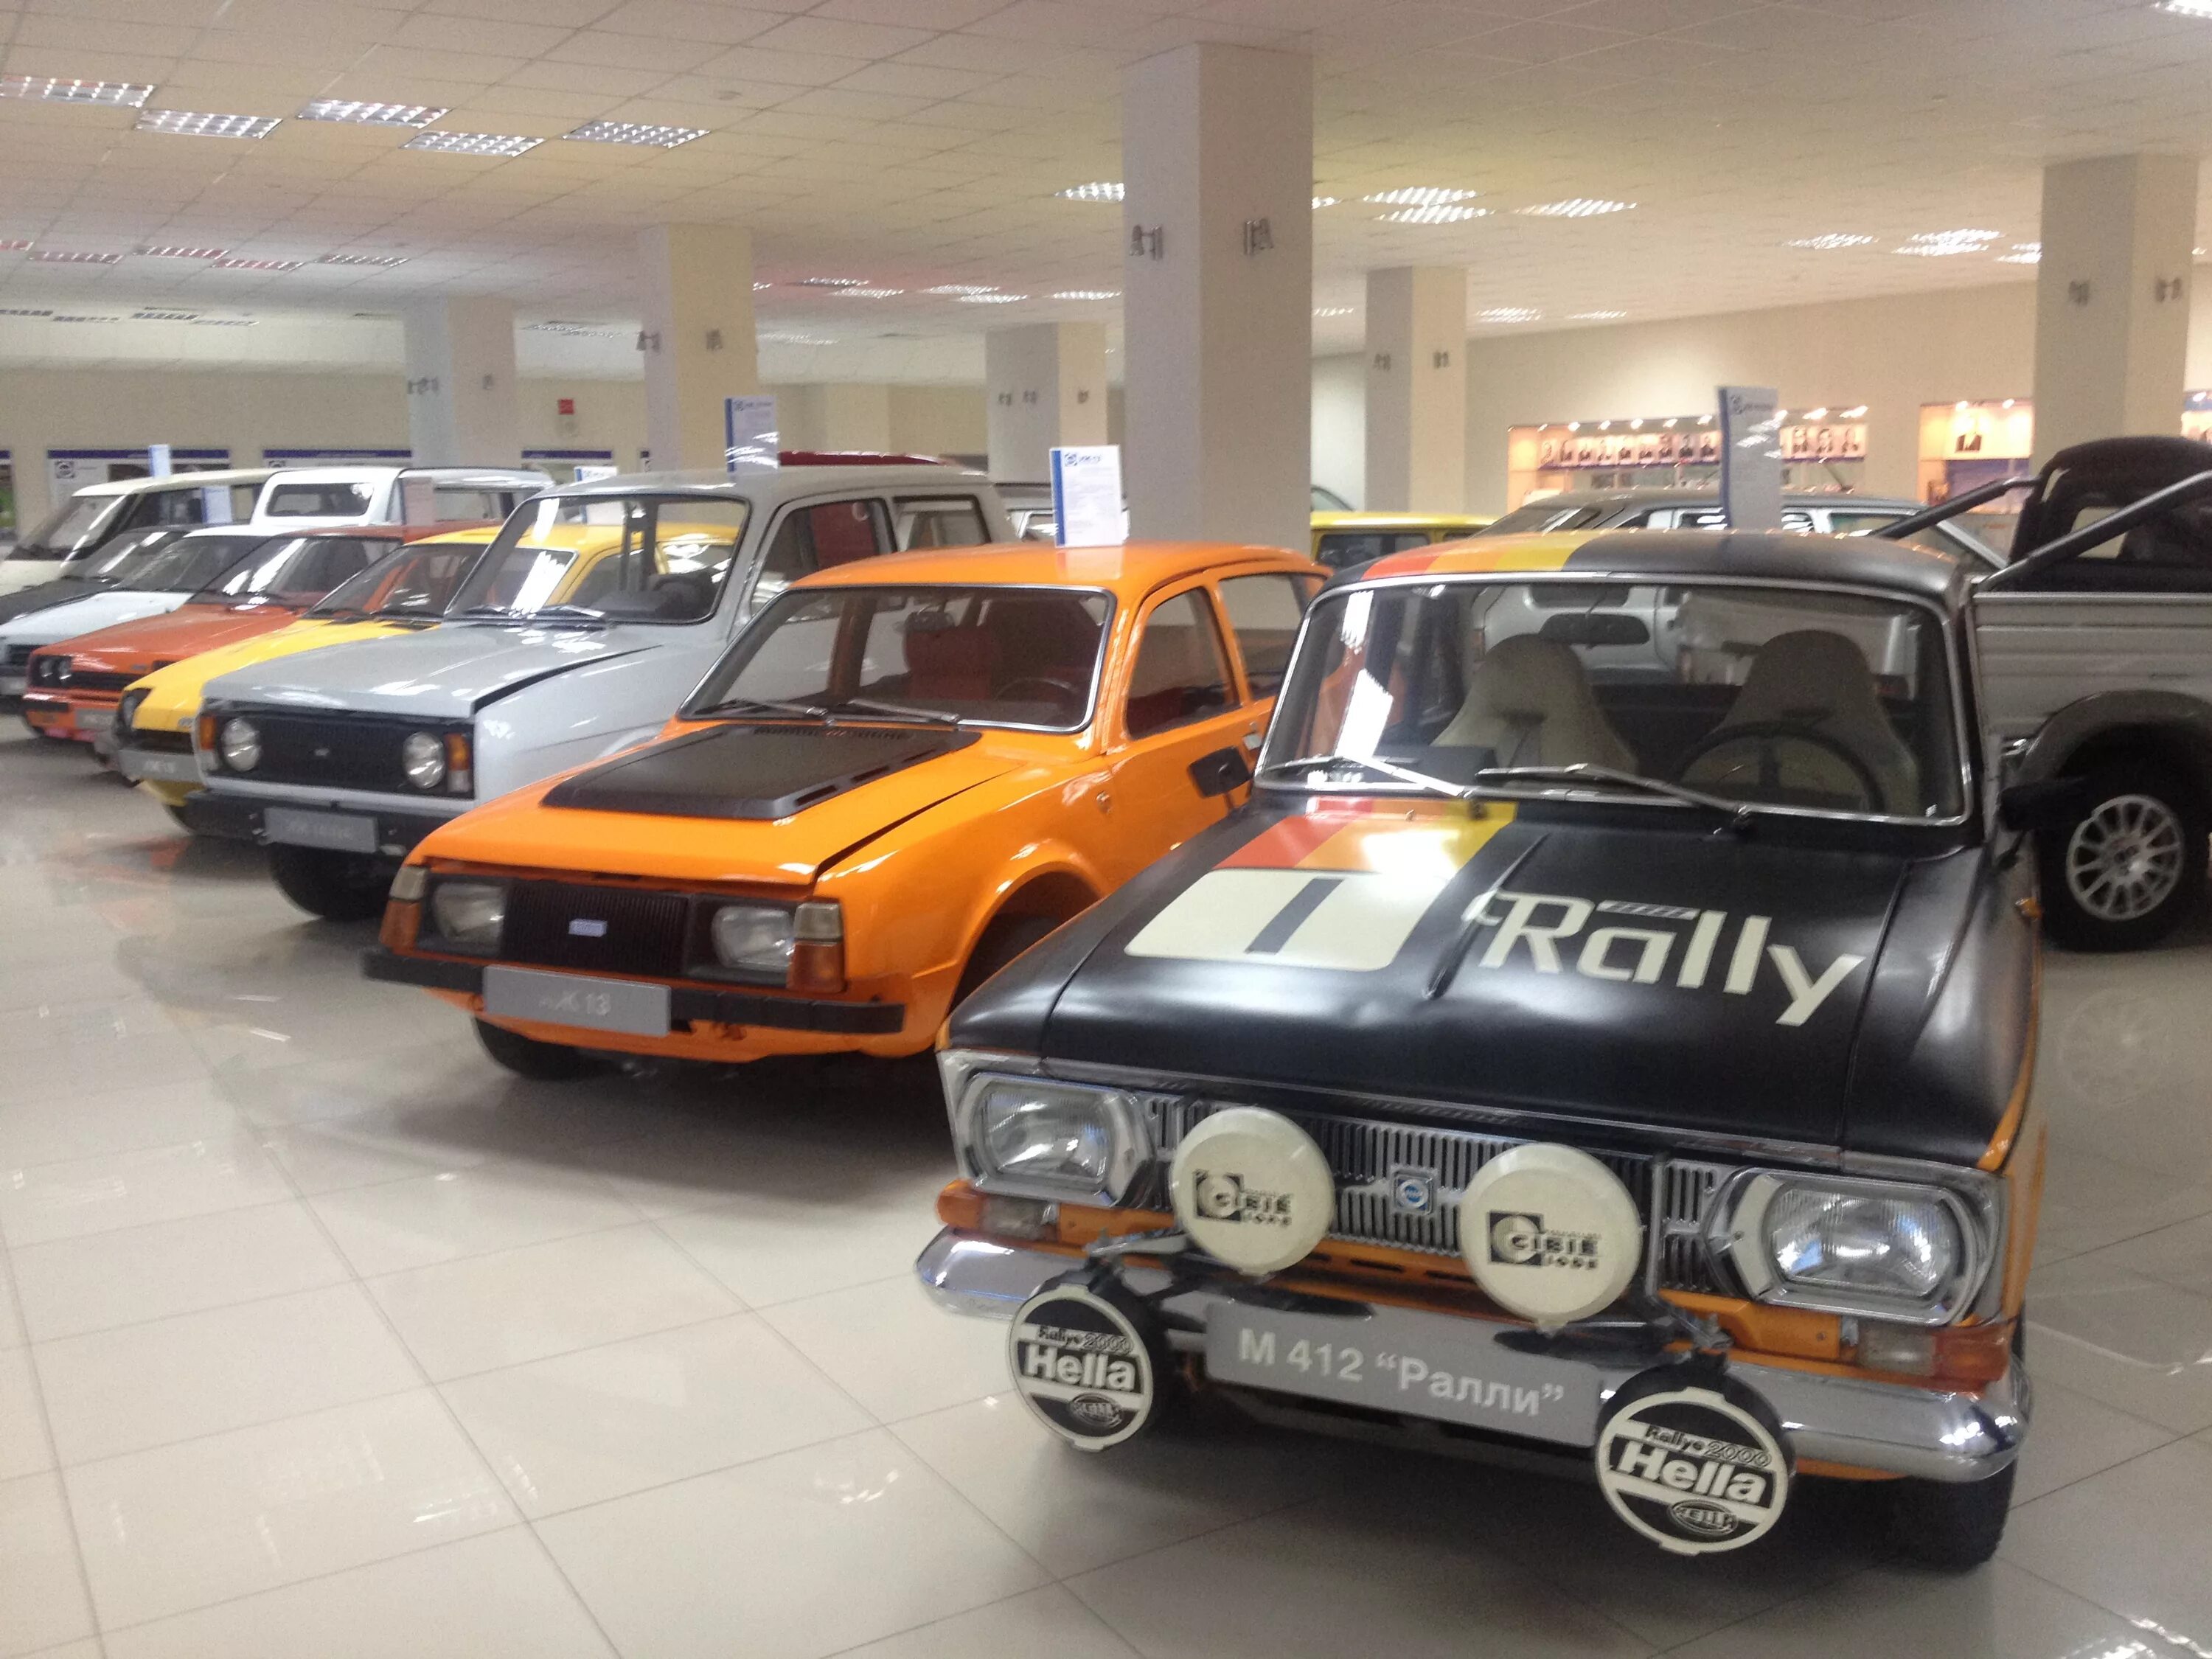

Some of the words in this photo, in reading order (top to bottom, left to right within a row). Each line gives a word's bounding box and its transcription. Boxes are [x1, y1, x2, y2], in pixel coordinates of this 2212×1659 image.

[1462, 887, 1865, 1027] Rally
[585, 992, 611, 1016] 13
[1512, 1234, 1599, 1255] CIBIE
[1080, 1332, 1133, 1356] 2000
[1237, 1327, 1276, 1366] М
[1286, 1338, 1364, 1382] 412
[1023, 1343, 1137, 1392] Hella
[1645, 1425, 1705, 1451] Rallye
[1703, 1440, 1773, 1468] 2000
[1618, 1439, 1767, 1505] Hella
